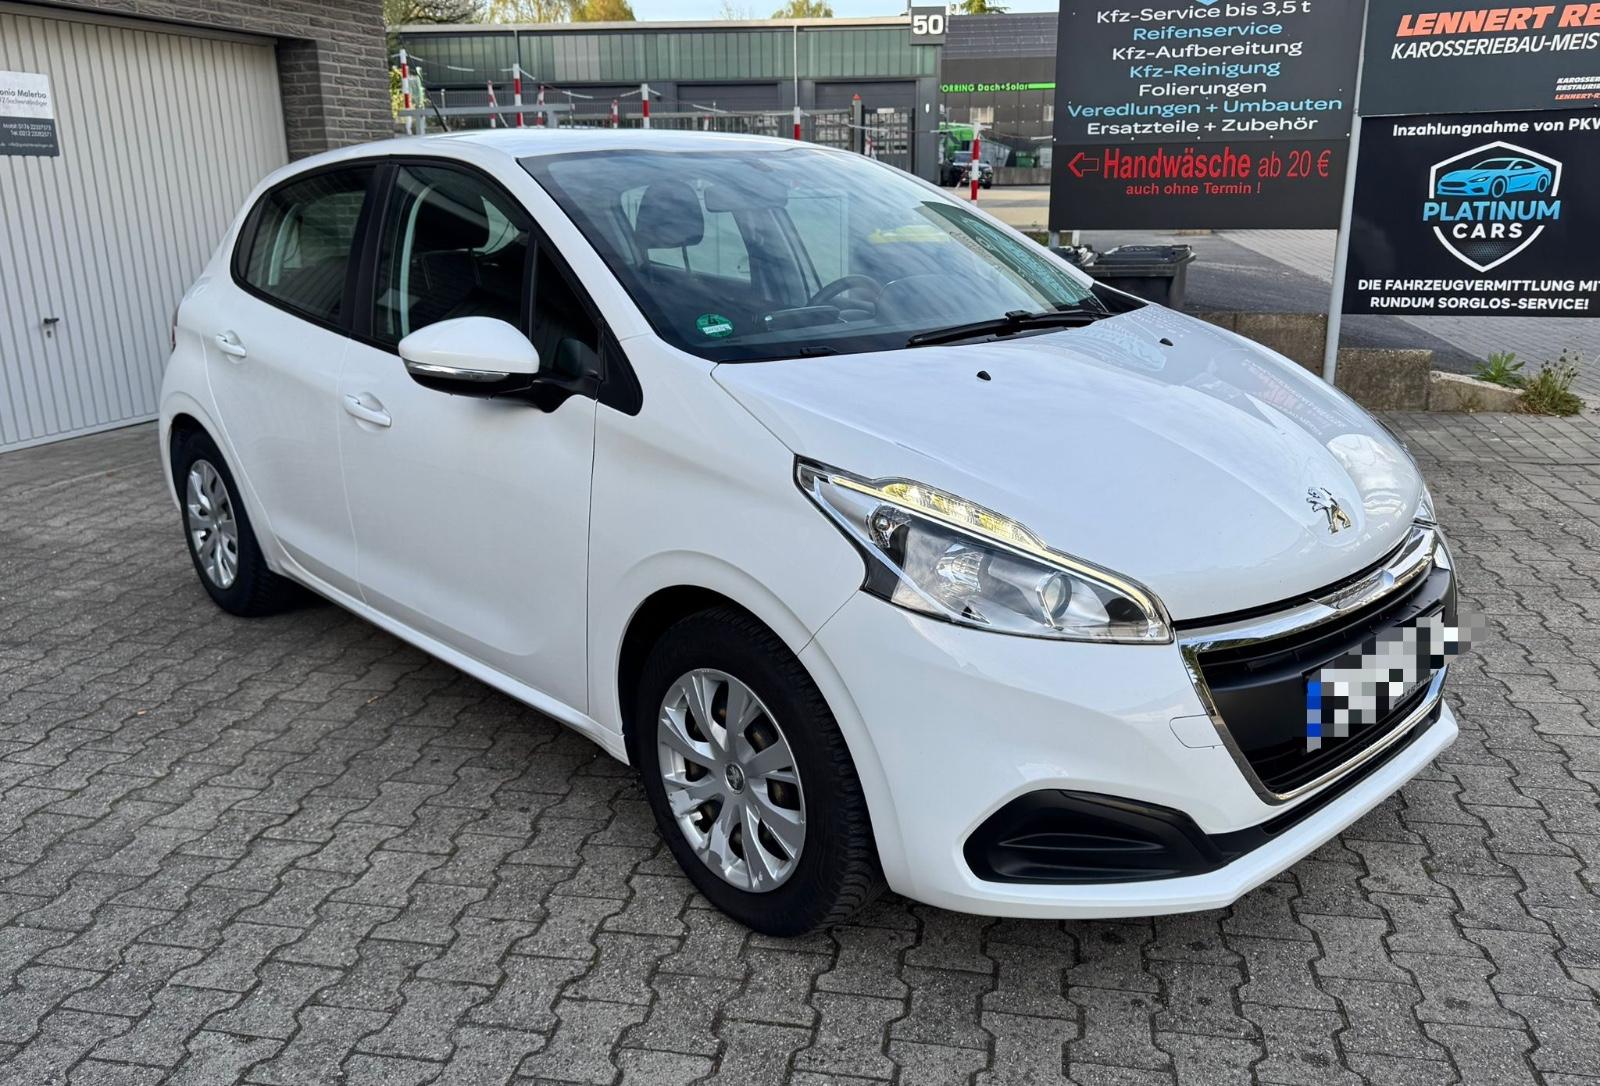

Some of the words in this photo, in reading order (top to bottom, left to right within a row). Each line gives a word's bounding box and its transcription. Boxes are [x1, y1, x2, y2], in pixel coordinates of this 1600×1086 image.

[1096, 4, 1221, 24] Kfz-Service
[1225, 3, 1258, 17] bis
[1262, 0, 1298, 16] 3,5
[1301, 1, 1312, 14] t
[1396, 6, 1556, 37] LENNERT
[912, 14, 944, 35] 50
[1133, 22, 1283, 41] Reifenservice
[1112, 40, 1304, 61] Kfz-Aufbereitung
[1390, 32, 1600, 60] KAROSSERIEBAU-MEIS
[1129, 61, 1281, 79] Kfz-Reinigung
[940, 83, 975, 93] ORRING
[1139, 81, 1267, 97] Folierungen
[1067, 103, 1200, 118] Veredlungen
[1205, 103, 1218, 114] +
[1222, 98, 1342, 113] Umbauten
[1087, 119, 1200, 135] Ersatzteile
[1204, 121, 1217, 132] +
[1221, 116, 1319, 132] Zubehör
[1393, 121, 1529, 137] Inzahlungnahme
[1533, 121, 1564, 132] von
[1103, 146, 1251, 180] Handwäsche
[1258, 151, 1281, 178] ab
[1286, 150, 1311, 178] 20
[1317, 149, 1331, 177] €
[1126, 182, 1159, 196] auch
[1164, 182, 1199, 196] ohne
[1204, 182, 1252, 196] Termin
[1256, 181, 1263, 195] !
[1423, 200, 1562, 222] PLATINUM
[1452, 222, 1524, 239] CARS
[1358, 279, 1381, 291] DIE
[1385, 279, 1575, 292] FAHRZEUGVERMITTLUNG
[1578, 280, 1600, 292] MI
[1370, 297, 1434, 309] RUNDUM
[1438, 297, 1589, 310] SORGLOS-SERVICE!
